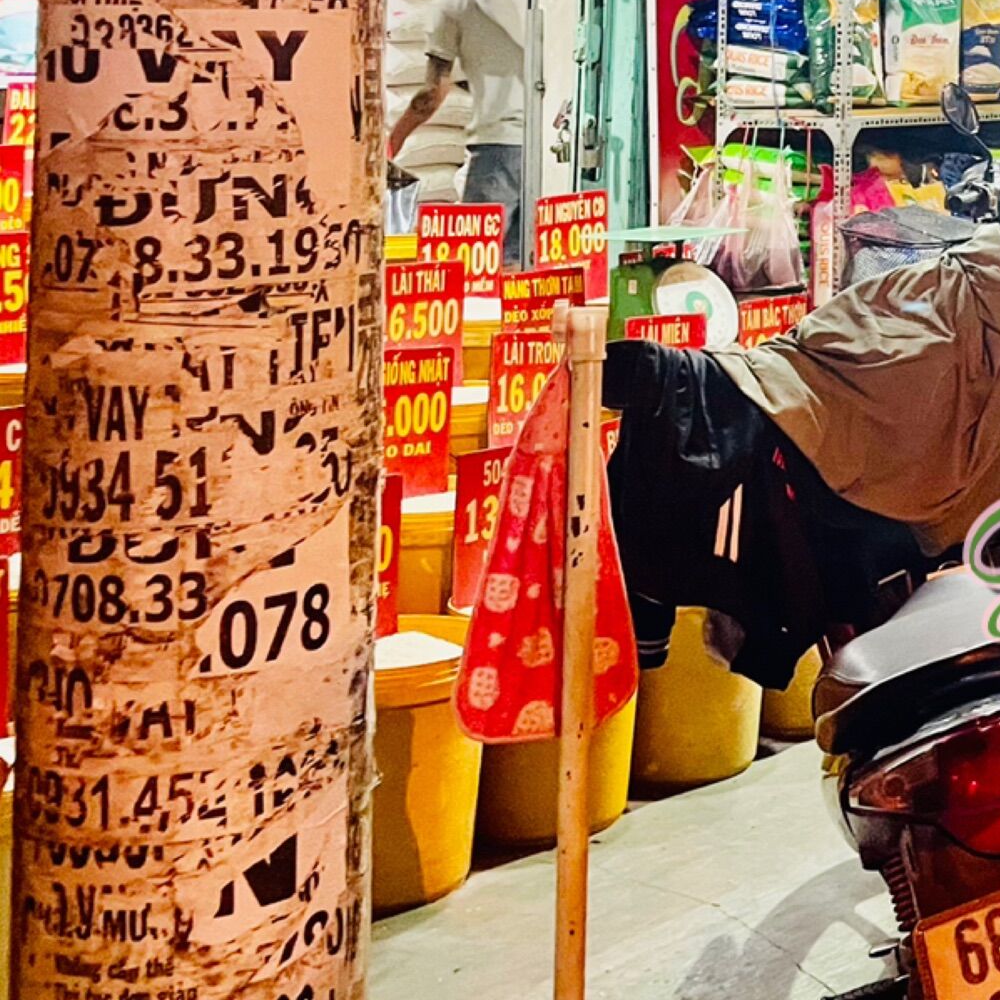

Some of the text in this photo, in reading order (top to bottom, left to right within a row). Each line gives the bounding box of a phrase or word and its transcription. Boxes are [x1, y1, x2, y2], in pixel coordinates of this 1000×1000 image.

[421, 210, 445, 238] ĐÀI
[447, 214, 481, 237] LOAN
[539, 221, 607, 263] 18.000
[391, 265, 447, 296] LÀI THÁI
[385, 297, 460, 343] 6.500
[504, 336, 524, 366] LÀI
